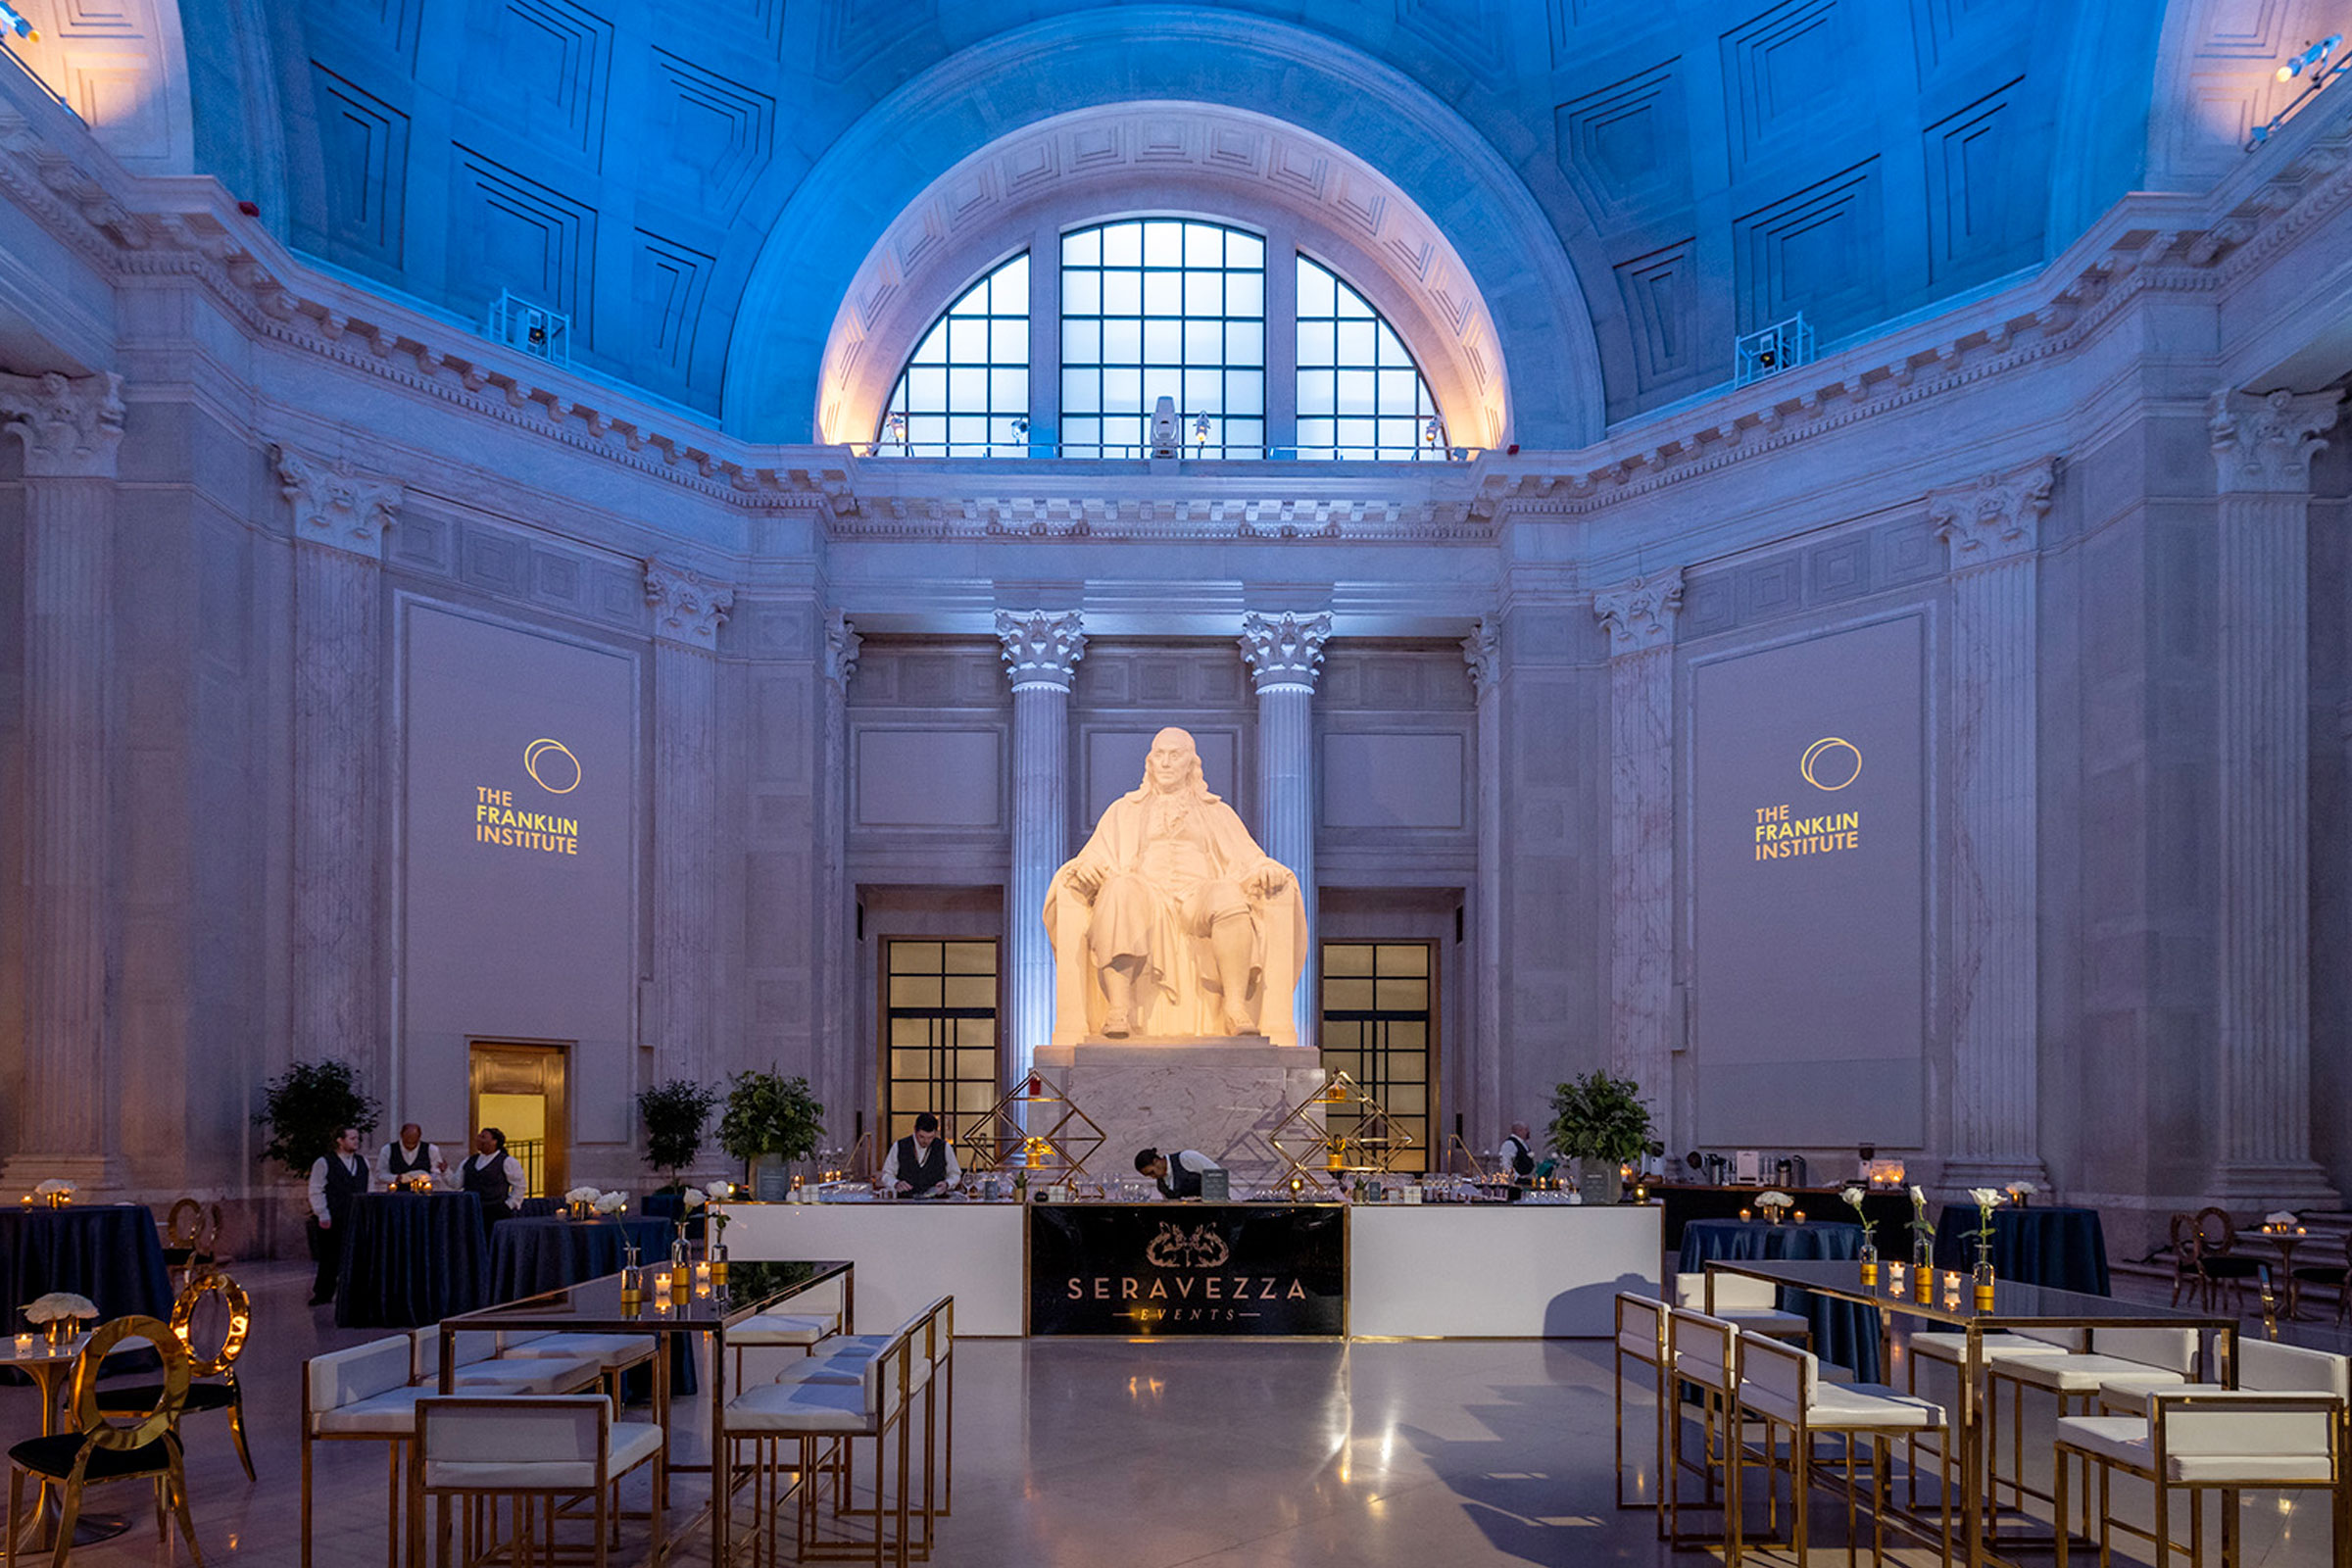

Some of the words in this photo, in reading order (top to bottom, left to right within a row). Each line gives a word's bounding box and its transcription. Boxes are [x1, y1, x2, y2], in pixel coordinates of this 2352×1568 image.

[476, 786, 512, 807] THE
[476, 805, 577, 836] FRANKLIN
[1755, 805, 1789, 823] THE
[1755, 811, 1858, 842] FRANKLIN
[476, 824, 577, 855] INSTITUTE
[1755, 831, 1858, 860] INSTITUTE
[1067, 1277, 1306, 1299] SERAVEZZA
[1141, 1307, 1235, 1321] EVENTS
